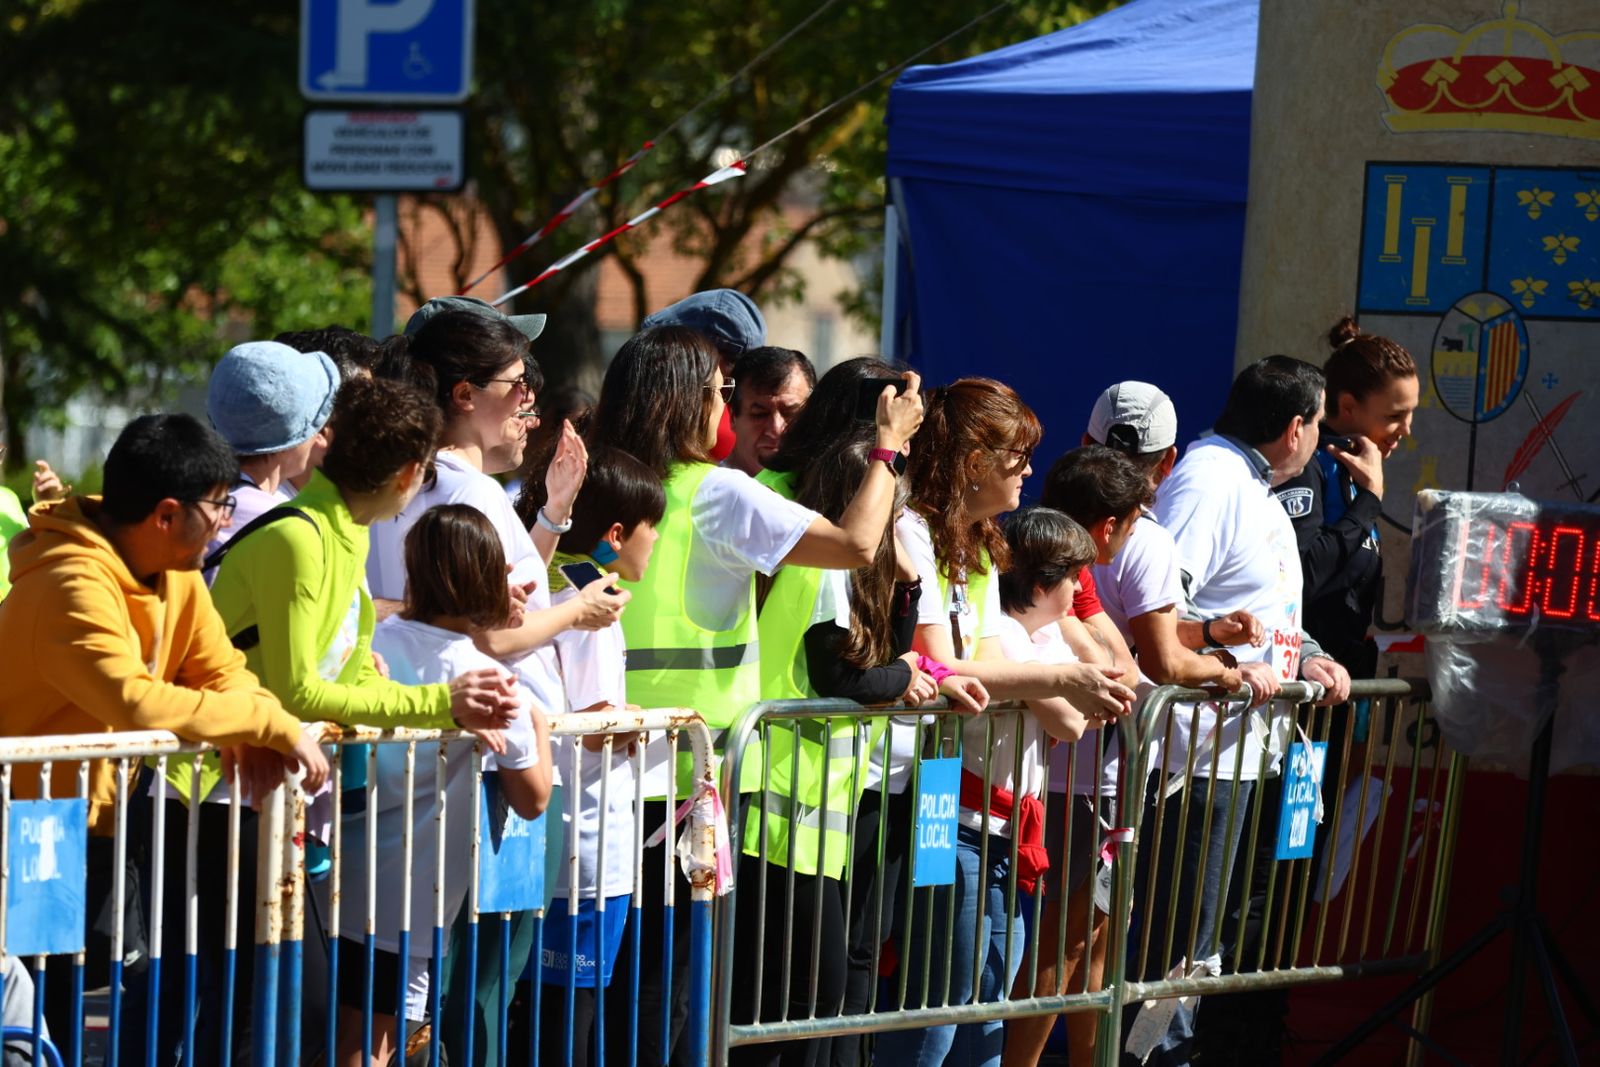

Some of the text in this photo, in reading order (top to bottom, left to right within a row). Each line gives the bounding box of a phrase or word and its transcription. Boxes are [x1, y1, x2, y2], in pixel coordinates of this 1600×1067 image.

[919, 793, 956, 819] POLICIA
[919, 823, 952, 849] LOCAL
[21, 855, 62, 883] LOL
